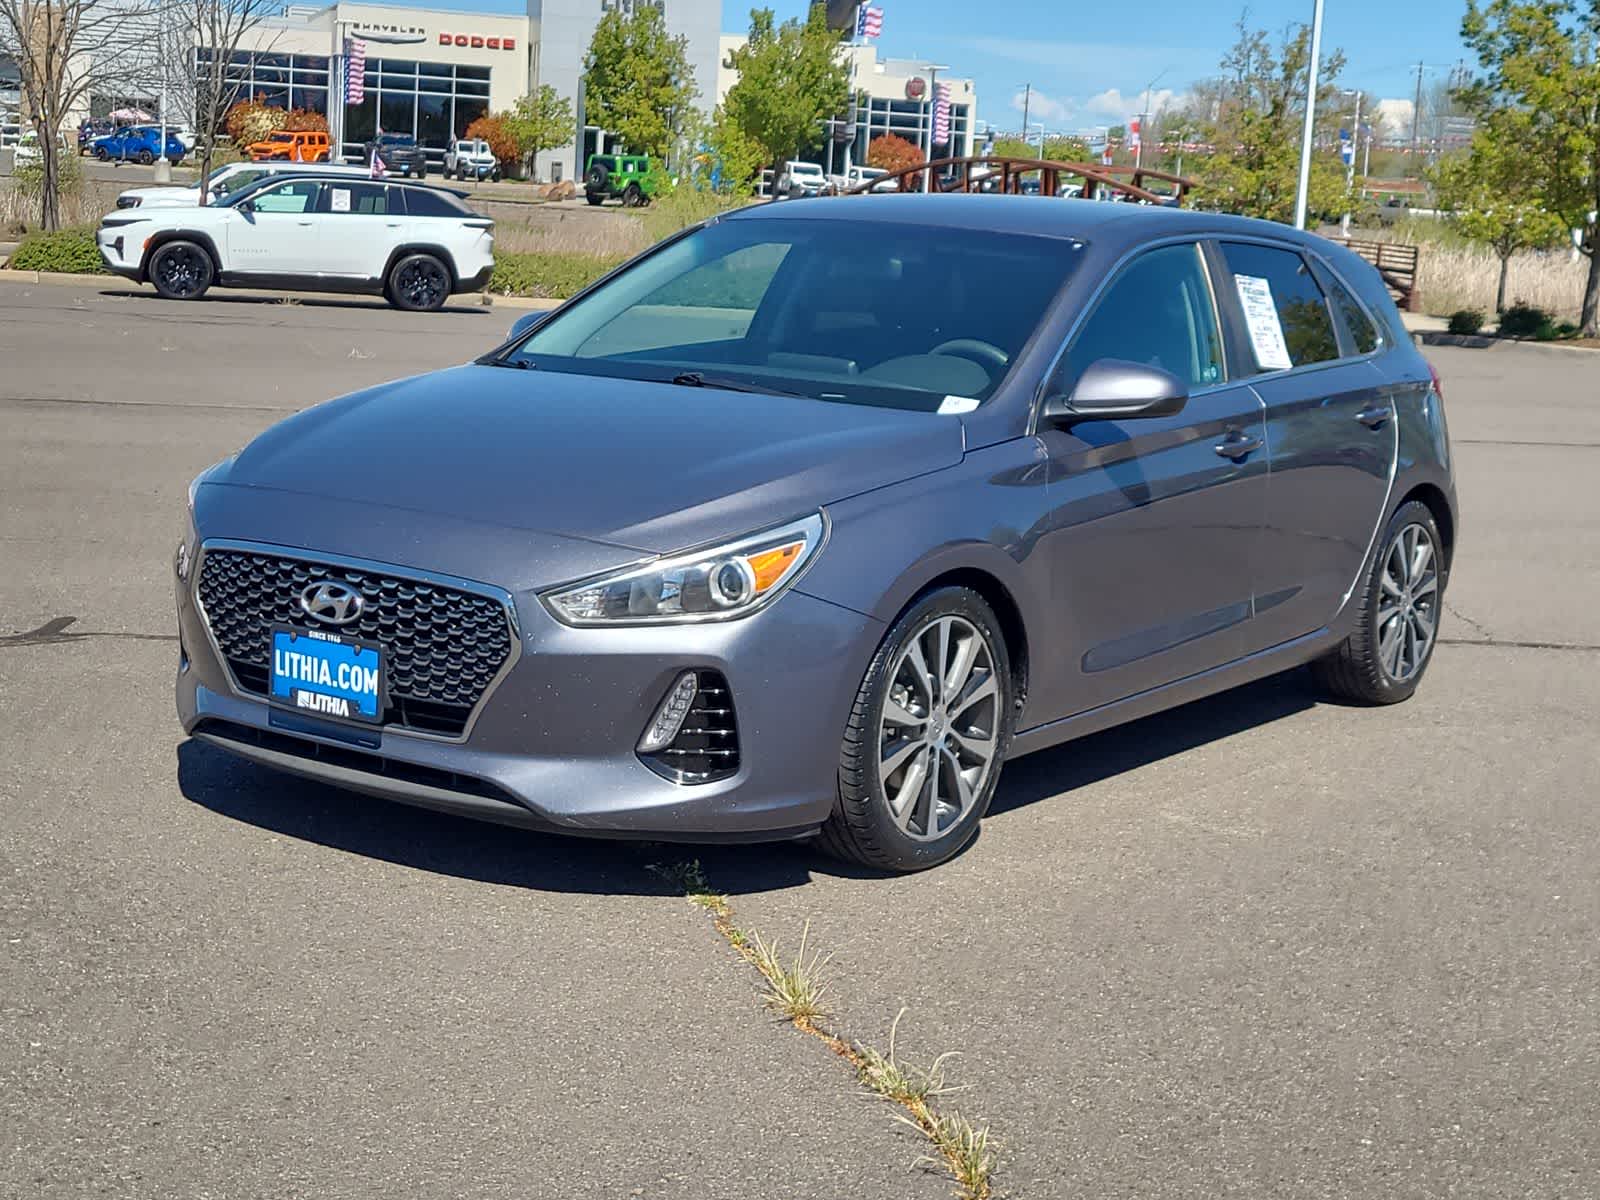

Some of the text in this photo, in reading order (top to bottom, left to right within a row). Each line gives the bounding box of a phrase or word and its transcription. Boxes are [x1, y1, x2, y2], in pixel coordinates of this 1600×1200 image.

[353, 22, 425, 35] CHRYSLER
[439, 33, 516, 51] DODGE
[308, 630, 327, 641] SINCE
[275, 648, 379, 697] LITHIA.COM
[309, 691, 350, 717] LITHIA
